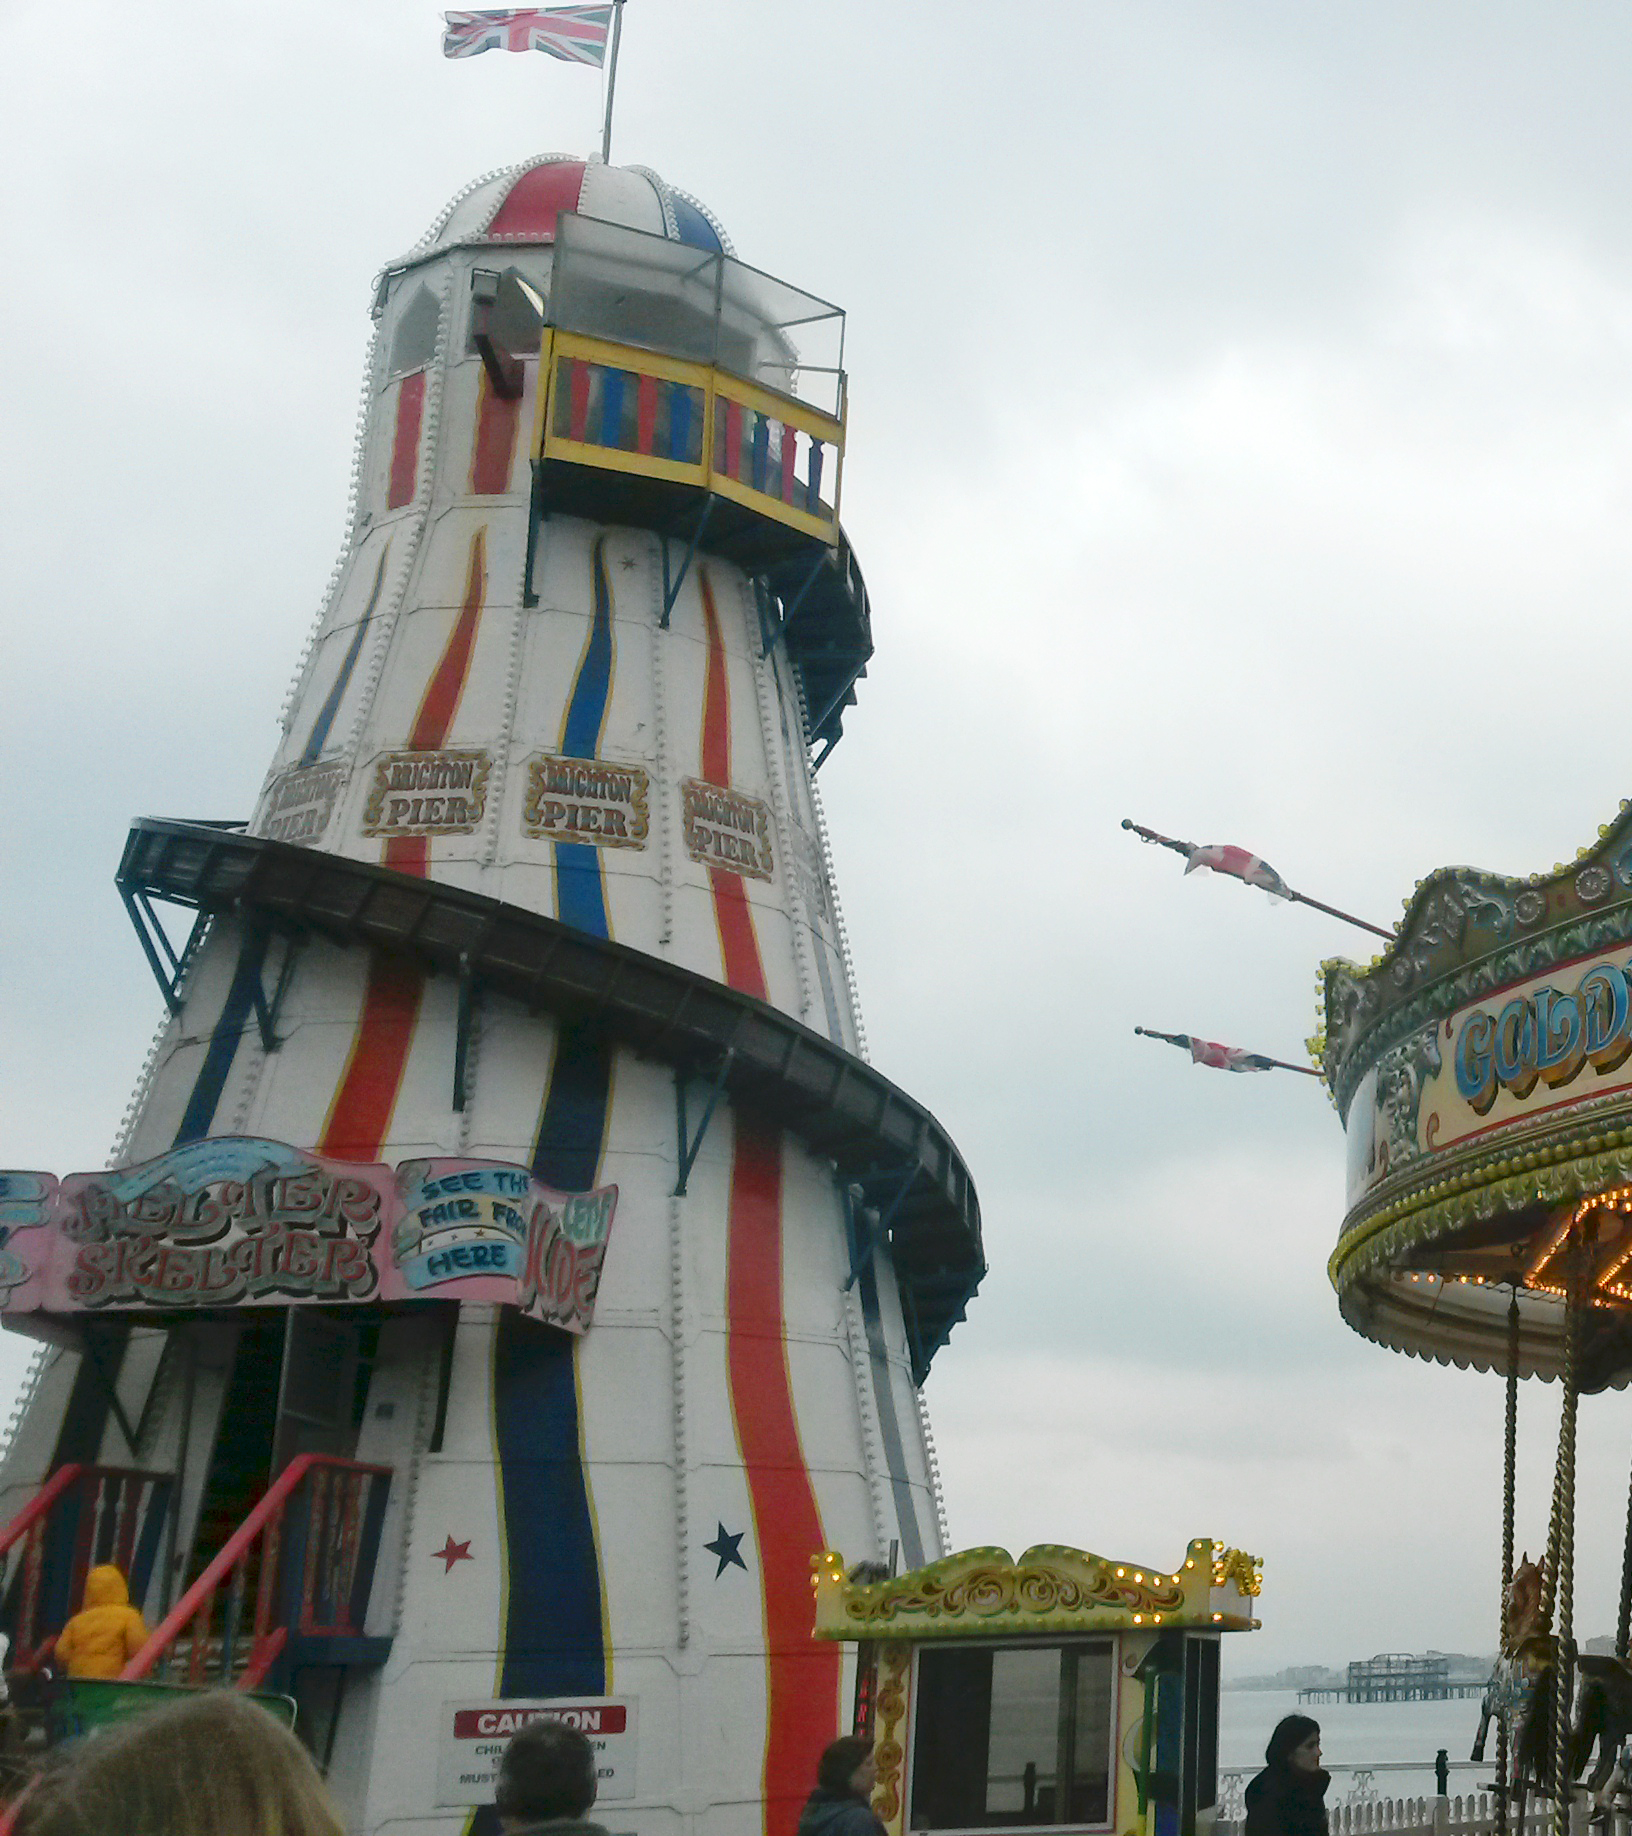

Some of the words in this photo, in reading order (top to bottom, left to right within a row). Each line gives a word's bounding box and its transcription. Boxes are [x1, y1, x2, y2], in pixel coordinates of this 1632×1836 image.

[387, 761, 473, 791] BRIGHTON
[543, 764, 632, 803] BRIGHTON
[386, 796, 469, 826] PIER
[542, 801, 628, 838] PIER
[692, 825, 759, 869] PIER
[421, 1172, 484, 1200] SEE
[60, 1172, 380, 1238] HELTER
[418, 1199, 482, 1229] FAIR
[67, 1222, 370, 1296] SKELTER
[427, 1245, 507, 1277] HERE
